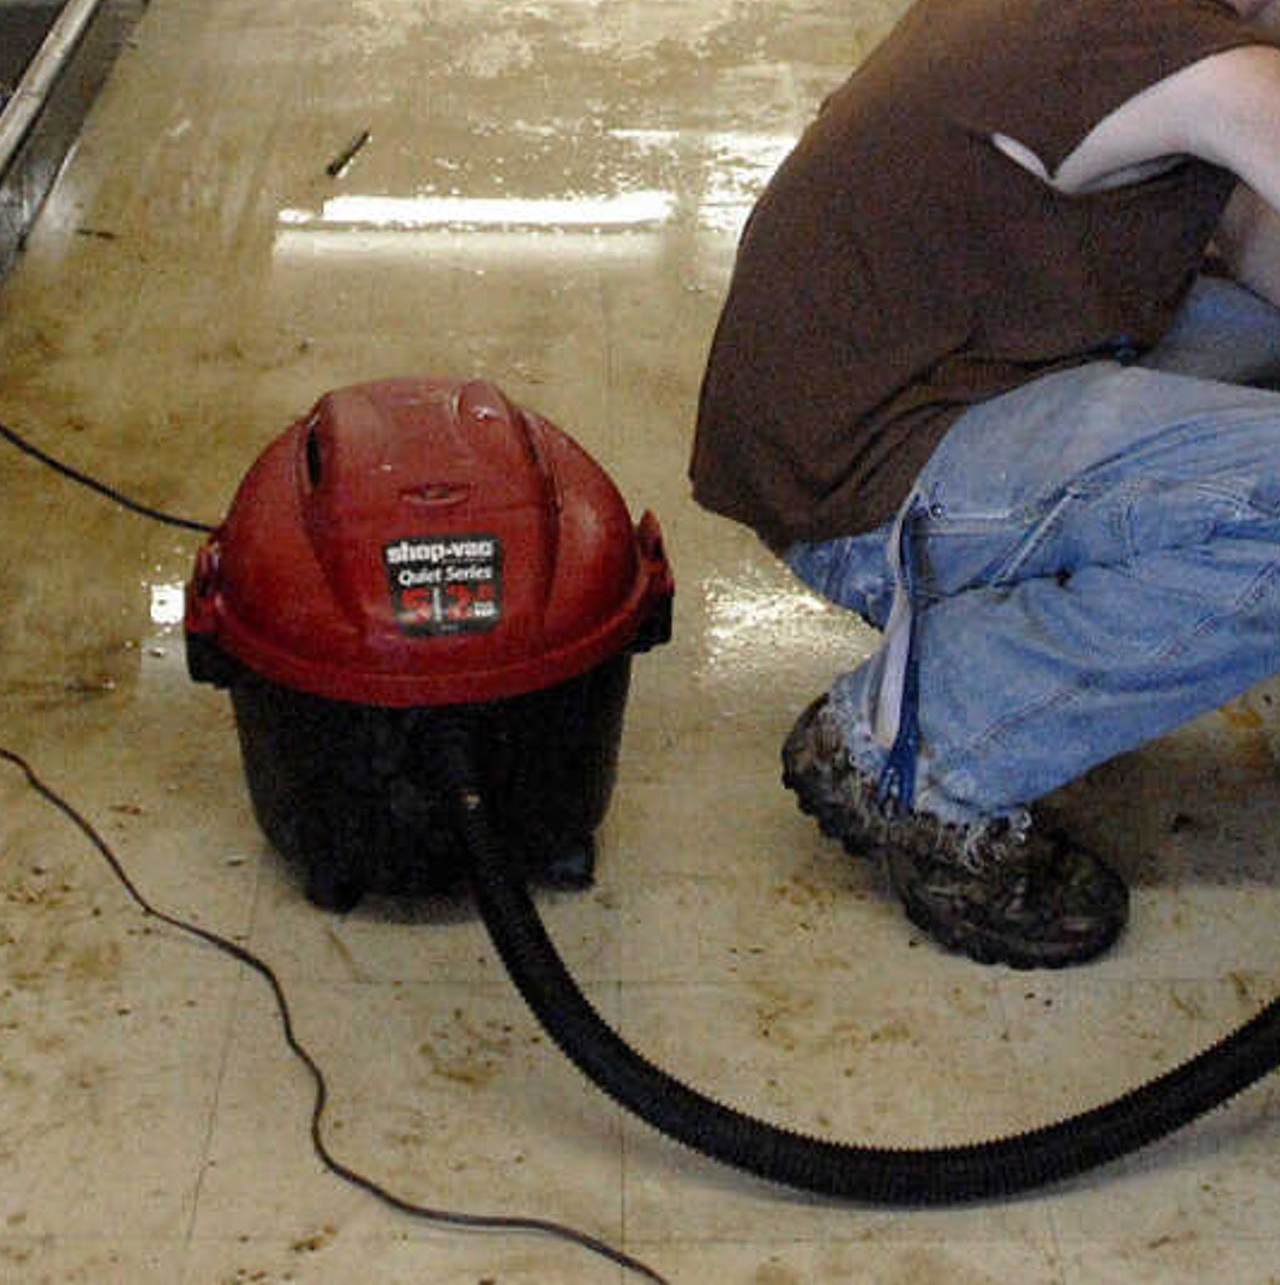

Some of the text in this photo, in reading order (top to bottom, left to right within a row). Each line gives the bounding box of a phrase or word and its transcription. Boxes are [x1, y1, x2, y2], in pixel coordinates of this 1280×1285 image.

[386, 541, 494, 565] shop-vac
[398, 565, 492, 588] Quiet Series
